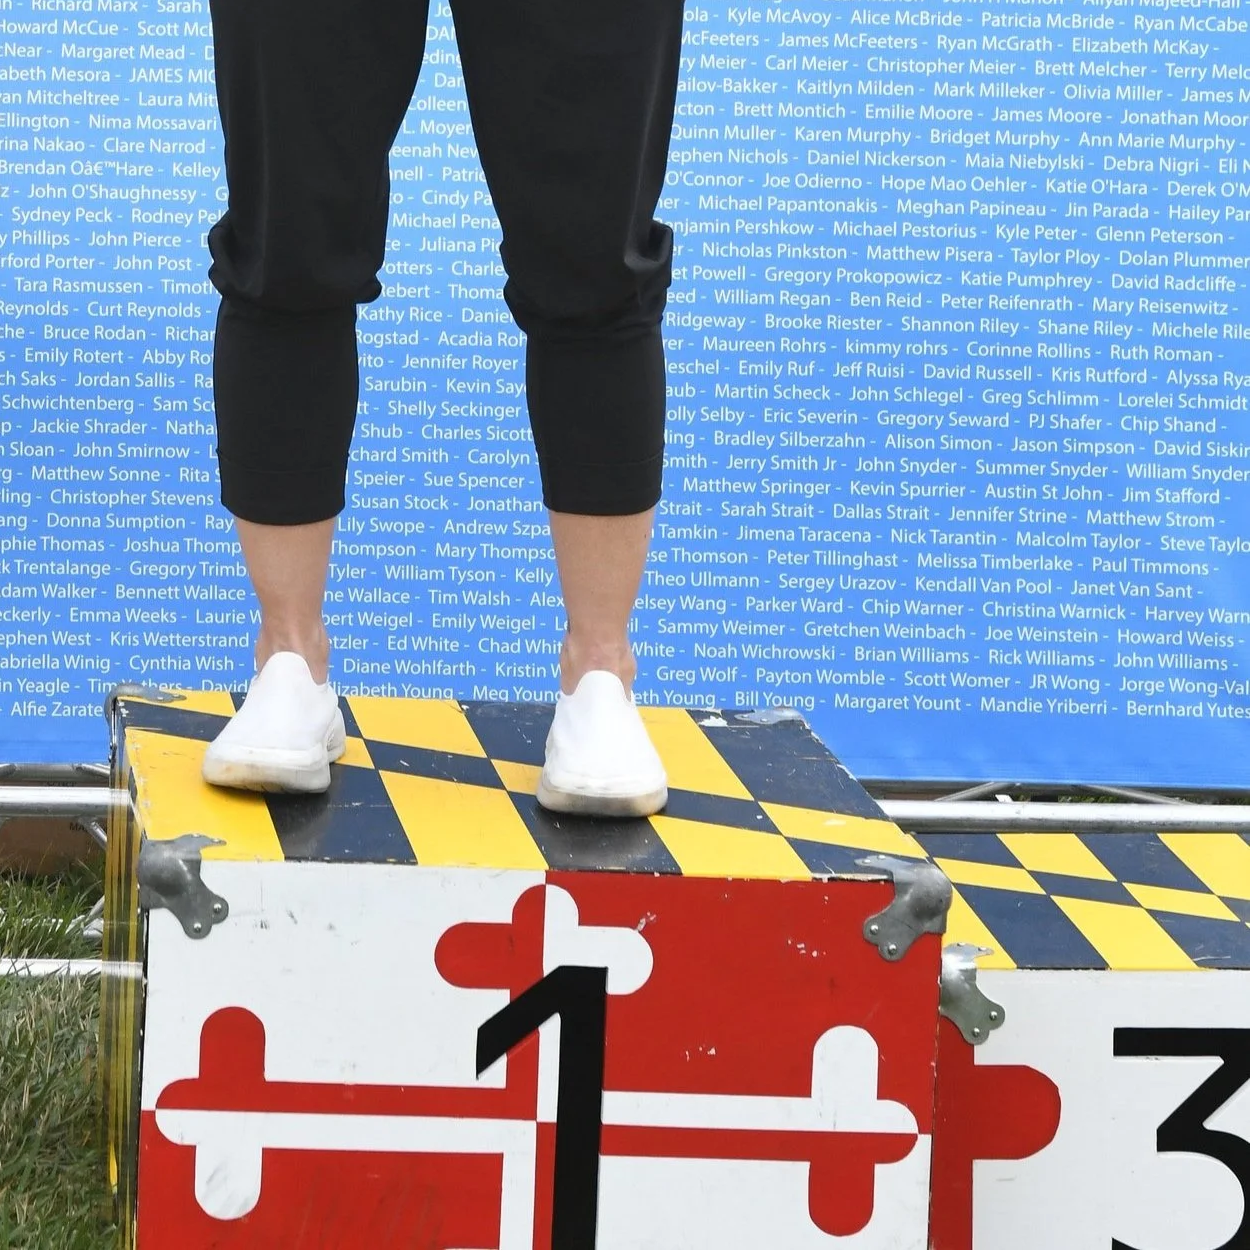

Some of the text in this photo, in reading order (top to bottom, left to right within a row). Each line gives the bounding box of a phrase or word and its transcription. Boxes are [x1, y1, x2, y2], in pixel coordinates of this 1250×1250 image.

[850, 9, 1115, 30] Alice McBride Patricia McBride
[795, 126, 1060, 150] Karen Murphy Bridget Murphy
[702, 241, 993, 263] Nicholas Pinkston Matthew Pisera
[739, 359, 904, 380] Emily Ruf Jeff Ruisi
[29, 417, 80, 434] Jackie
[84, 418, 148, 435] Shrader
[423, 471, 525, 491] Sue Spencer
[804, 621, 1098, 643] Gretchen Weinbach Joe Weinstein
[387, 635, 460, 652] Ed White
[343, 658, 476, 676] Diane Wohlfarth
[656, 665, 886, 687] Greg Wolf Payton Womble
[10, 700, 47, 717] Alfie
[51, 701, 105, 717] Zarate
[476, 965, 608, 1250] 1
[1111, 1027, 1250, 1250] 3
